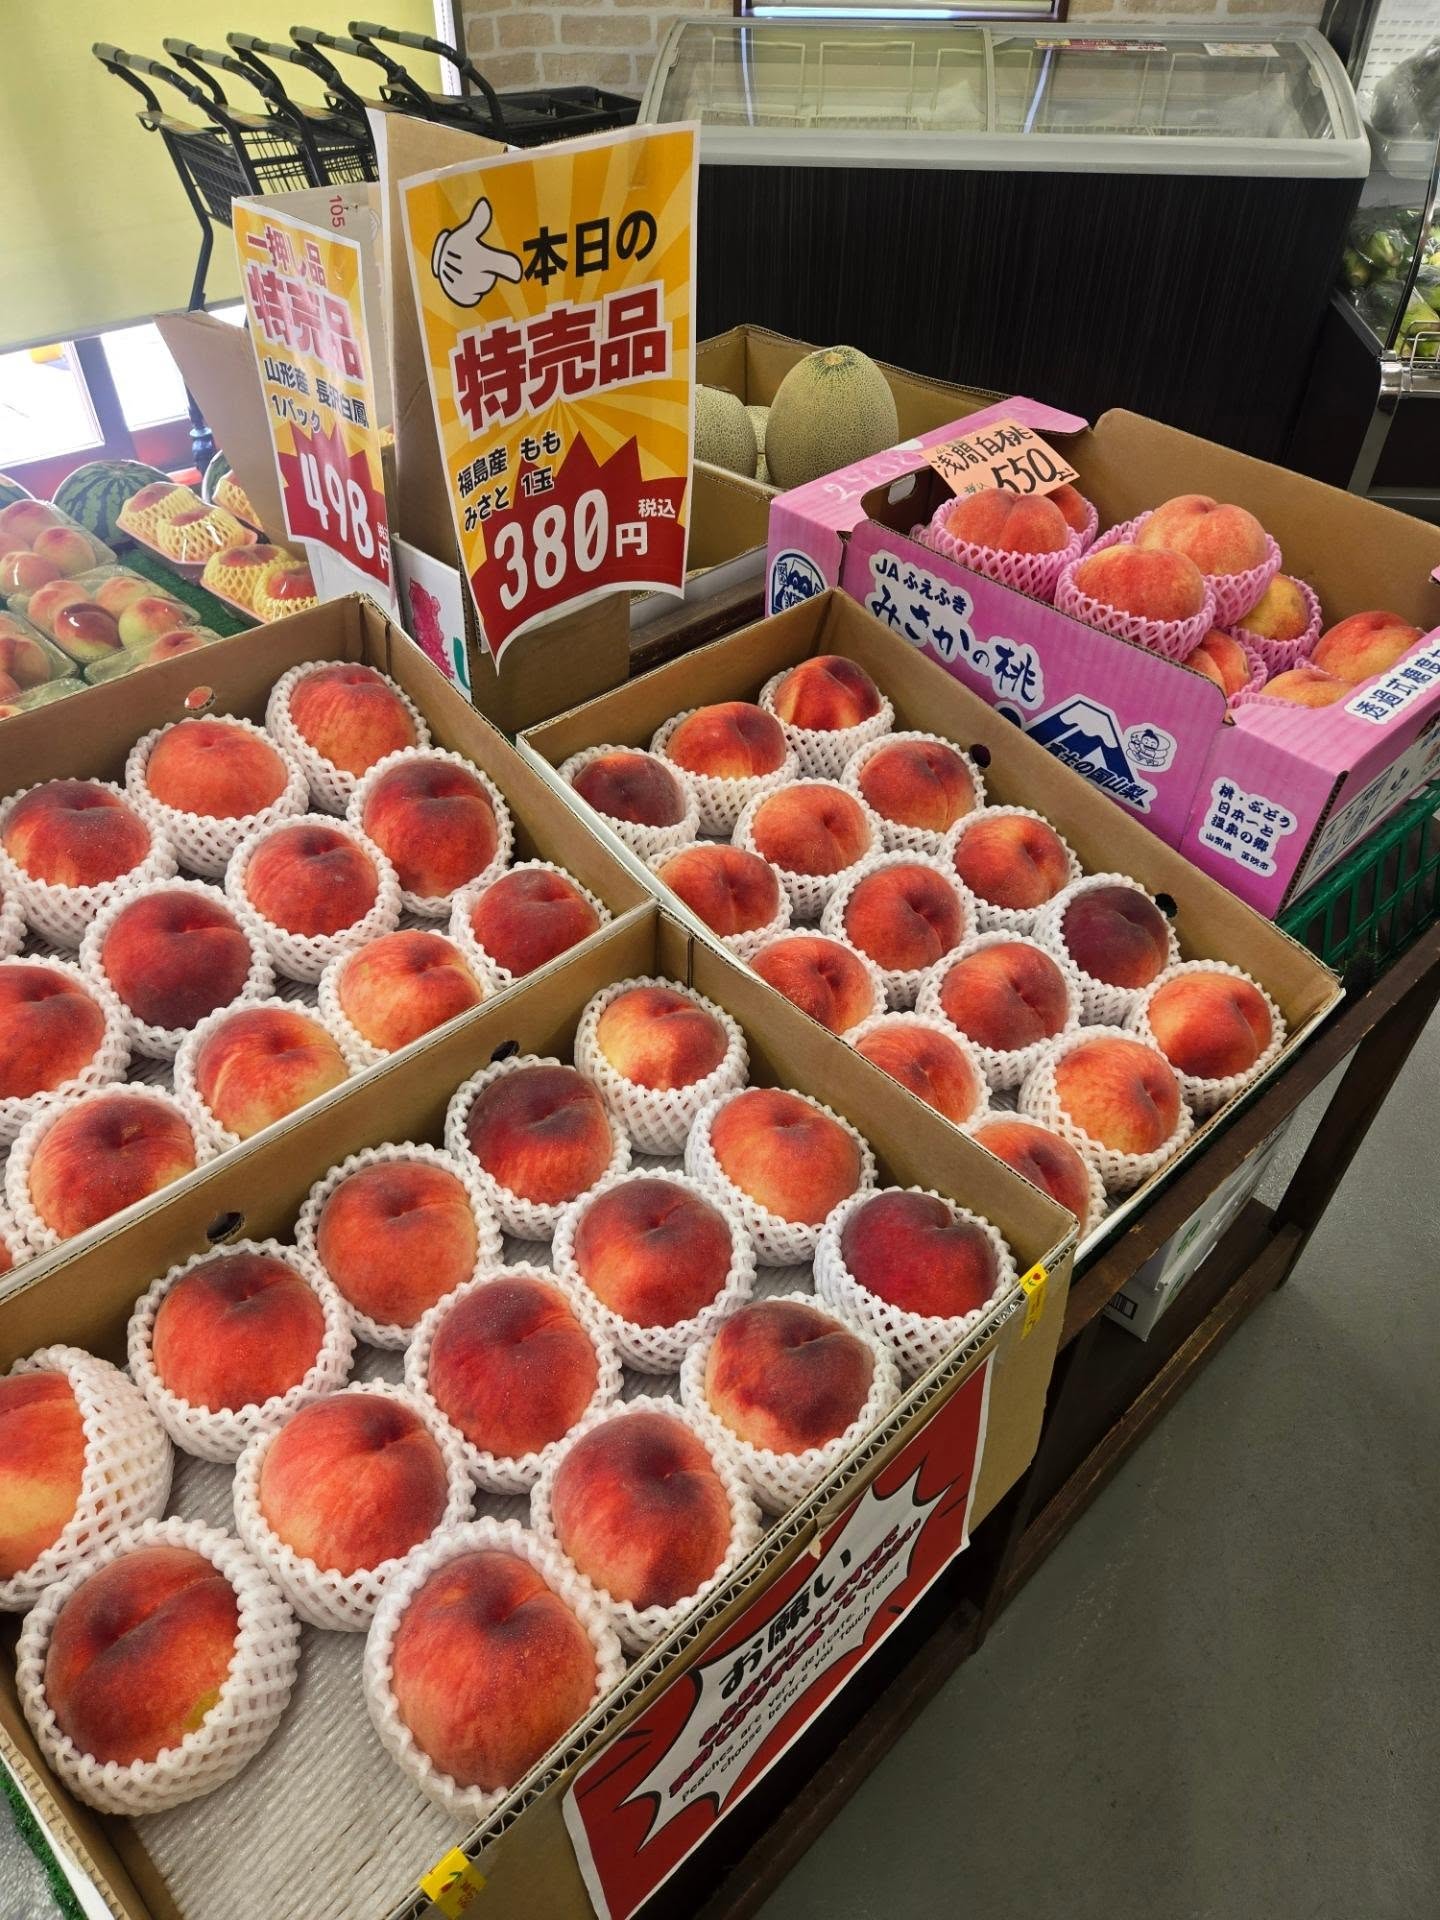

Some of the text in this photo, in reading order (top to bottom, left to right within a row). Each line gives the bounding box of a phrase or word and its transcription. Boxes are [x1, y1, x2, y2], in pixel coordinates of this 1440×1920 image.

[329, 195, 345, 228] 105
[247, 226, 327, 286] 一押し品
[522, 210, 657, 286] 本日の
[247, 265, 364, 380] 特売品
[264, 358, 309, 395] 山形産
[455, 287, 666, 430] 特売品
[272, 395, 321, 432] 1パック
[458, 431, 561, 497] 福島産 もも
[464, 467, 554, 531] みさと 1玉
[638, 498, 676, 518] 税込
[872, 585, 1037, 702] みさかの桃
[1211, 814, 1269, 852] 温泉の郷
[1218, 801, 1274, 838] 日本一と
[718, 1548, 852, 1699] お願い
[680, 1744, 734, 1803] Peaches
[740, 1712, 762, 1739] are
[768, 1678, 795, 1708] very
[863, 1561, 900, 1604] Please
[720, 1725, 762, 1774] choose
[768, 1673, 807, 1720] before
[813, 1645, 834, 1671] you
